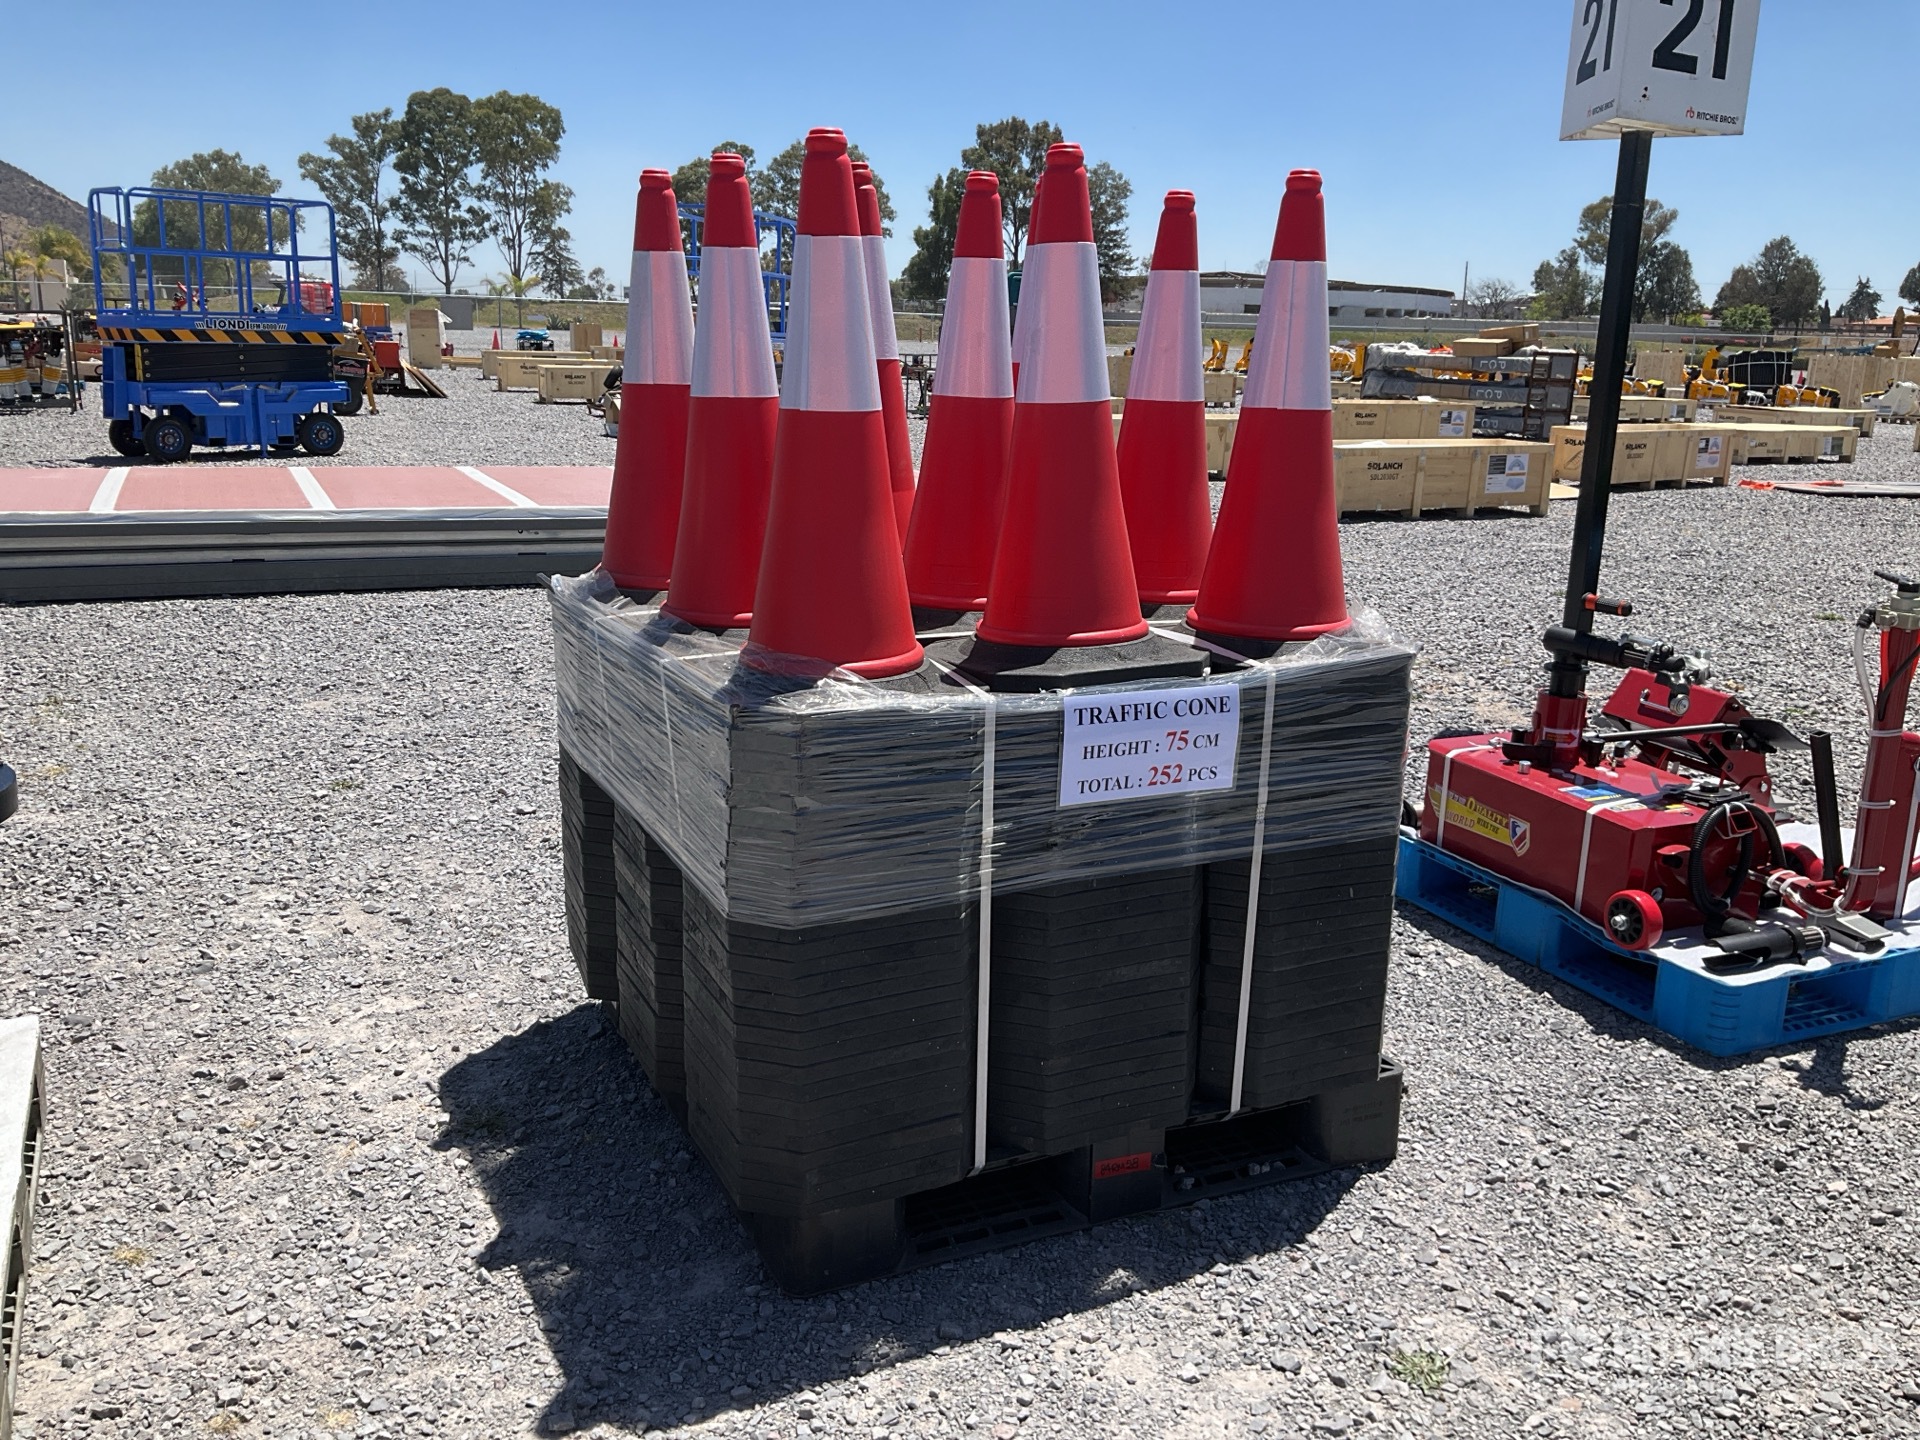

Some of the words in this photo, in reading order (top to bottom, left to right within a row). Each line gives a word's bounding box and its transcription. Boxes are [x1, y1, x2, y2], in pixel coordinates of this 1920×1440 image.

[1576, 0, 1618, 85] 21
[1652, 0, 1734, 80] 21
[1696, 111, 1719, 122] RITCHIE
[205, 319, 250, 329] LIONDI
[1367, 462, 1403, 470] SOLANCH
[1074, 701, 1168, 726] TRAFFIC
[1173, 696, 1231, 717] CONE
[1165, 730, 1190, 752] 75
[1192, 733, 1220, 749] CM
[1147, 764, 1182, 786] 252
[1187, 766, 1218, 782] PCS
[1446, 810, 1475, 828] WORLD
[1467, 797, 1508, 826] QUALITY
